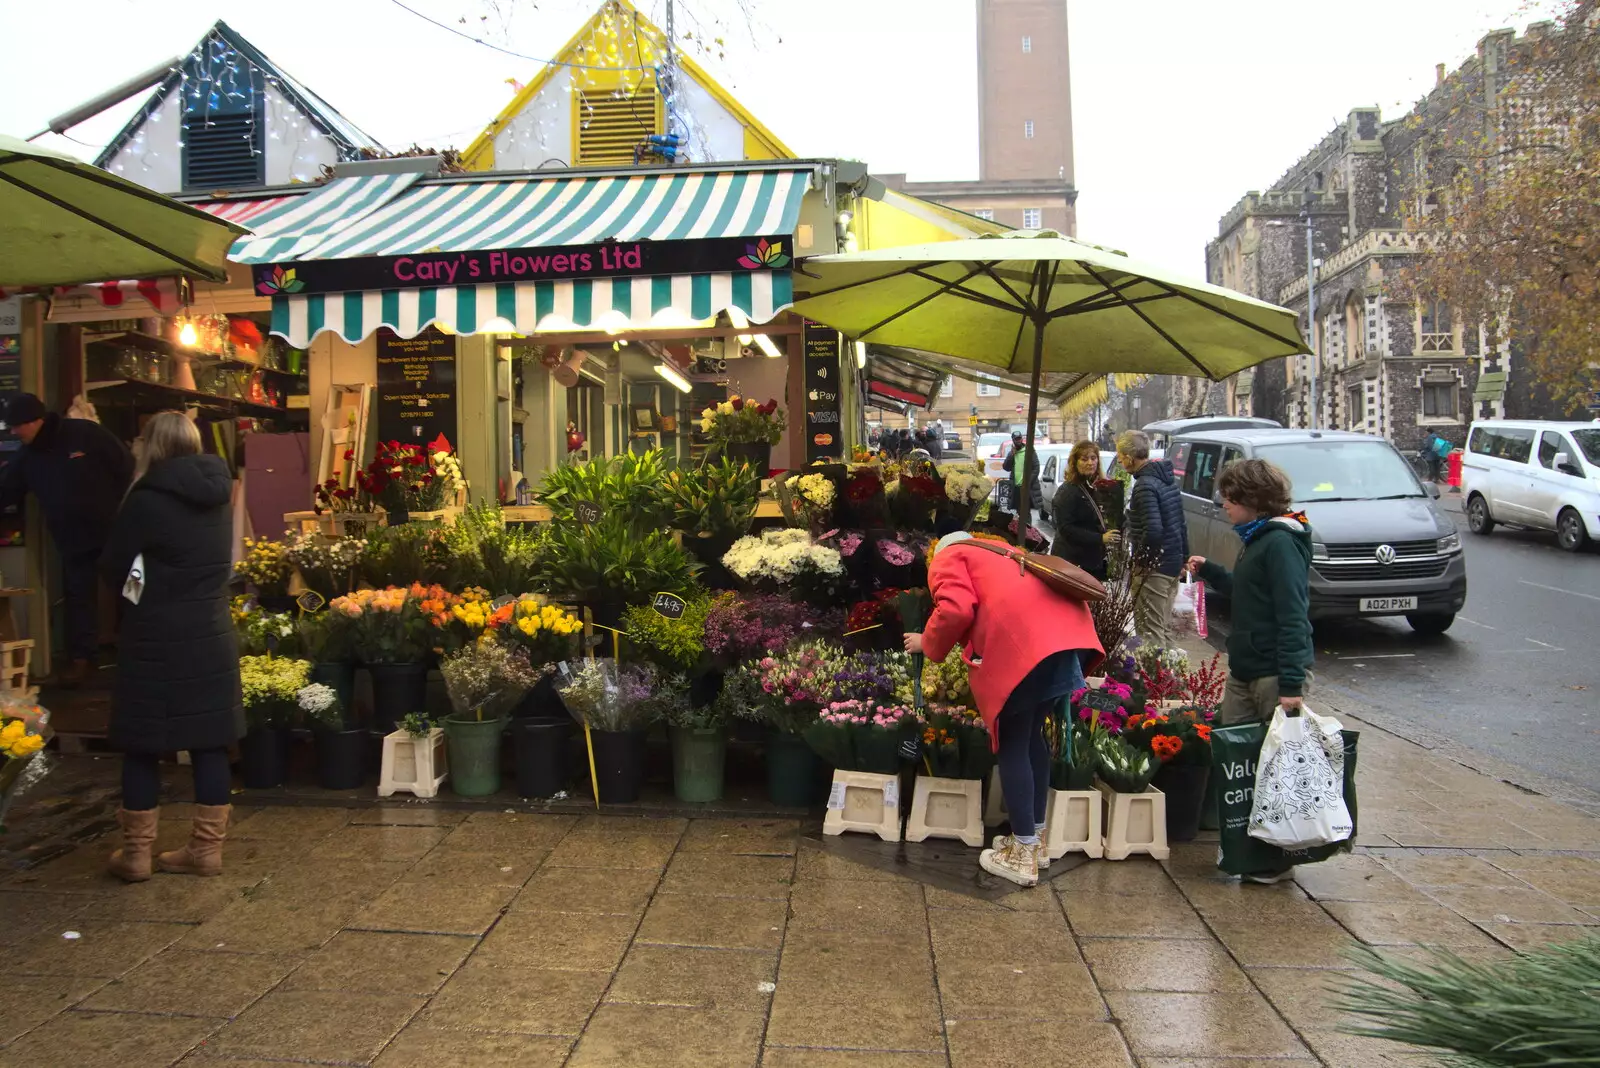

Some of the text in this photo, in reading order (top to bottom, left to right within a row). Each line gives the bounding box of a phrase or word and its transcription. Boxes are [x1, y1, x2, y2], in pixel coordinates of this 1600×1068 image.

[394, 244, 642, 283] Cary's Flowers Ltd
[820, 391, 836, 401] Pay
[808, 411, 839, 423] VISA
[1391, 598, 1412, 609] PXH
